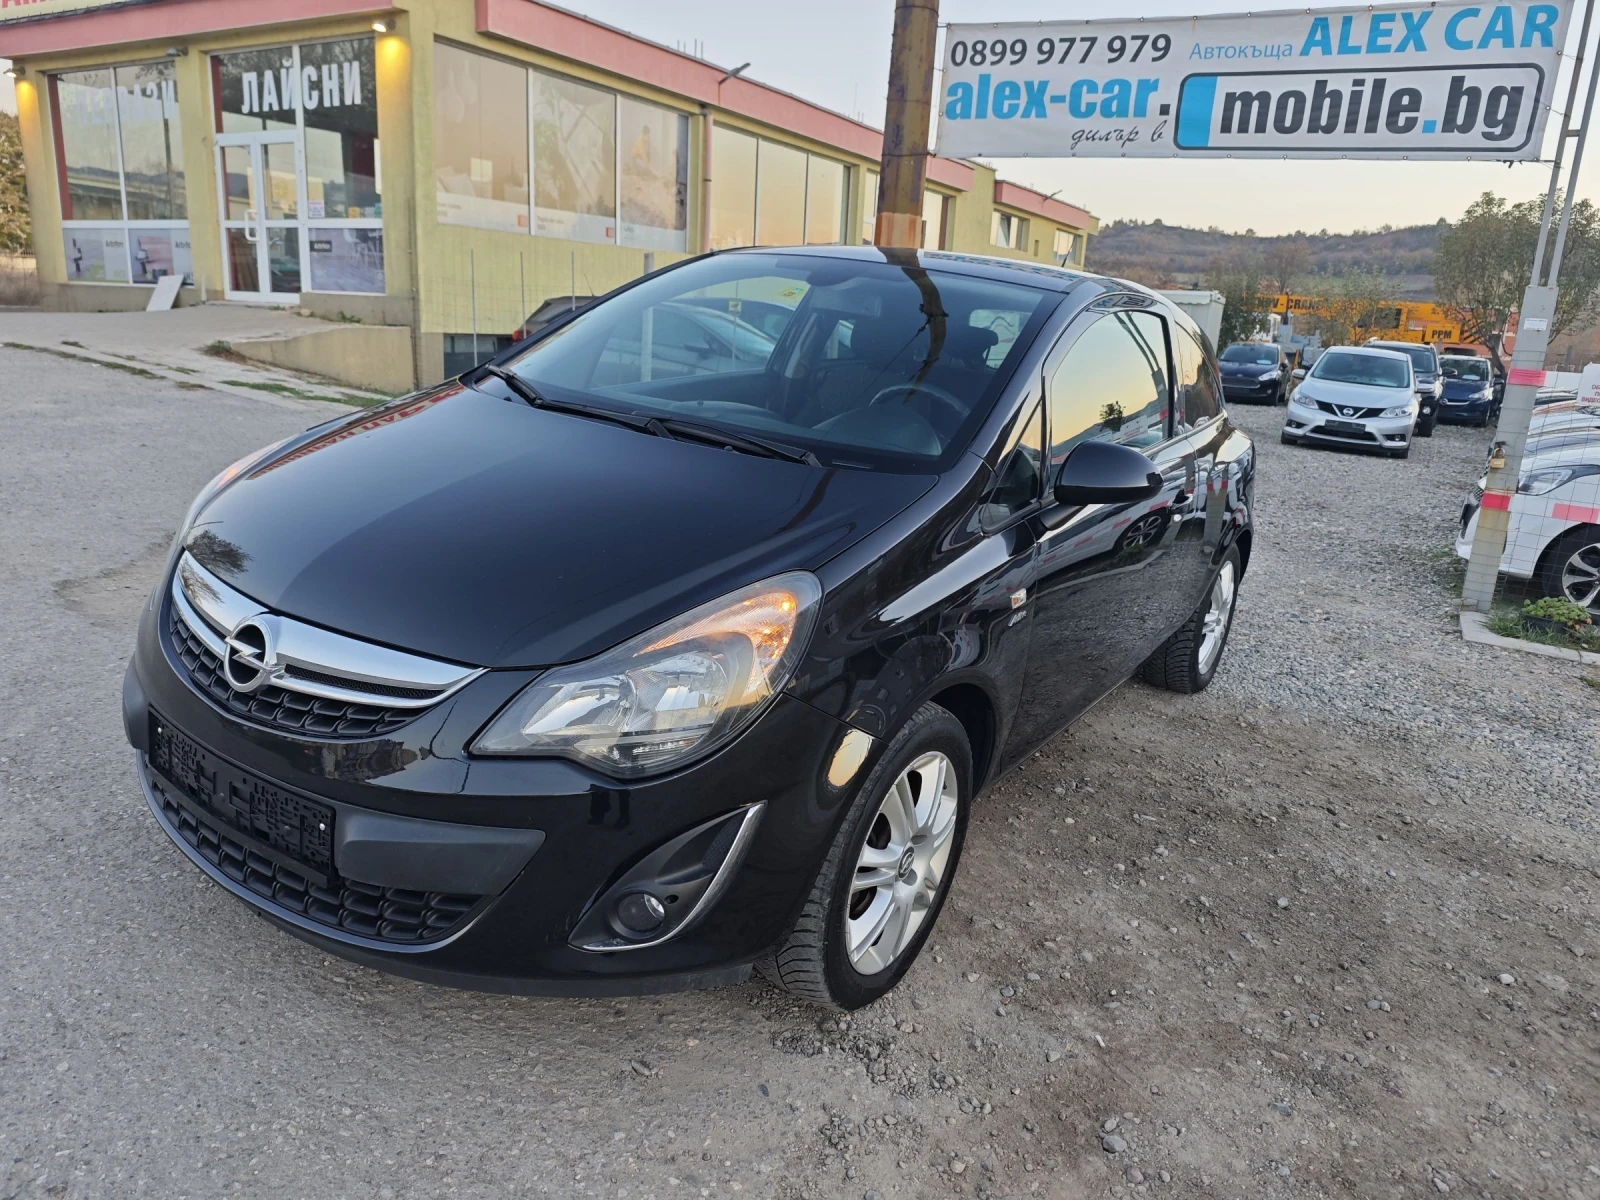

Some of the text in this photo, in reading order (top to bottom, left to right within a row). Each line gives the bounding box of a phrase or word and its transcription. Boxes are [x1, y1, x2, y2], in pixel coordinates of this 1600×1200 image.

[950, 33, 1172, 66] 0899 977 979
[1189, 4, 1559, 61] Автокъща ALEX CAR
[241, 57, 362, 114] ЛАЙСНИ
[1219, 75, 1525, 142] mobile.bg
[1070, 125, 1140, 150] дилър
[1431, 329, 1452, 340] PPM
